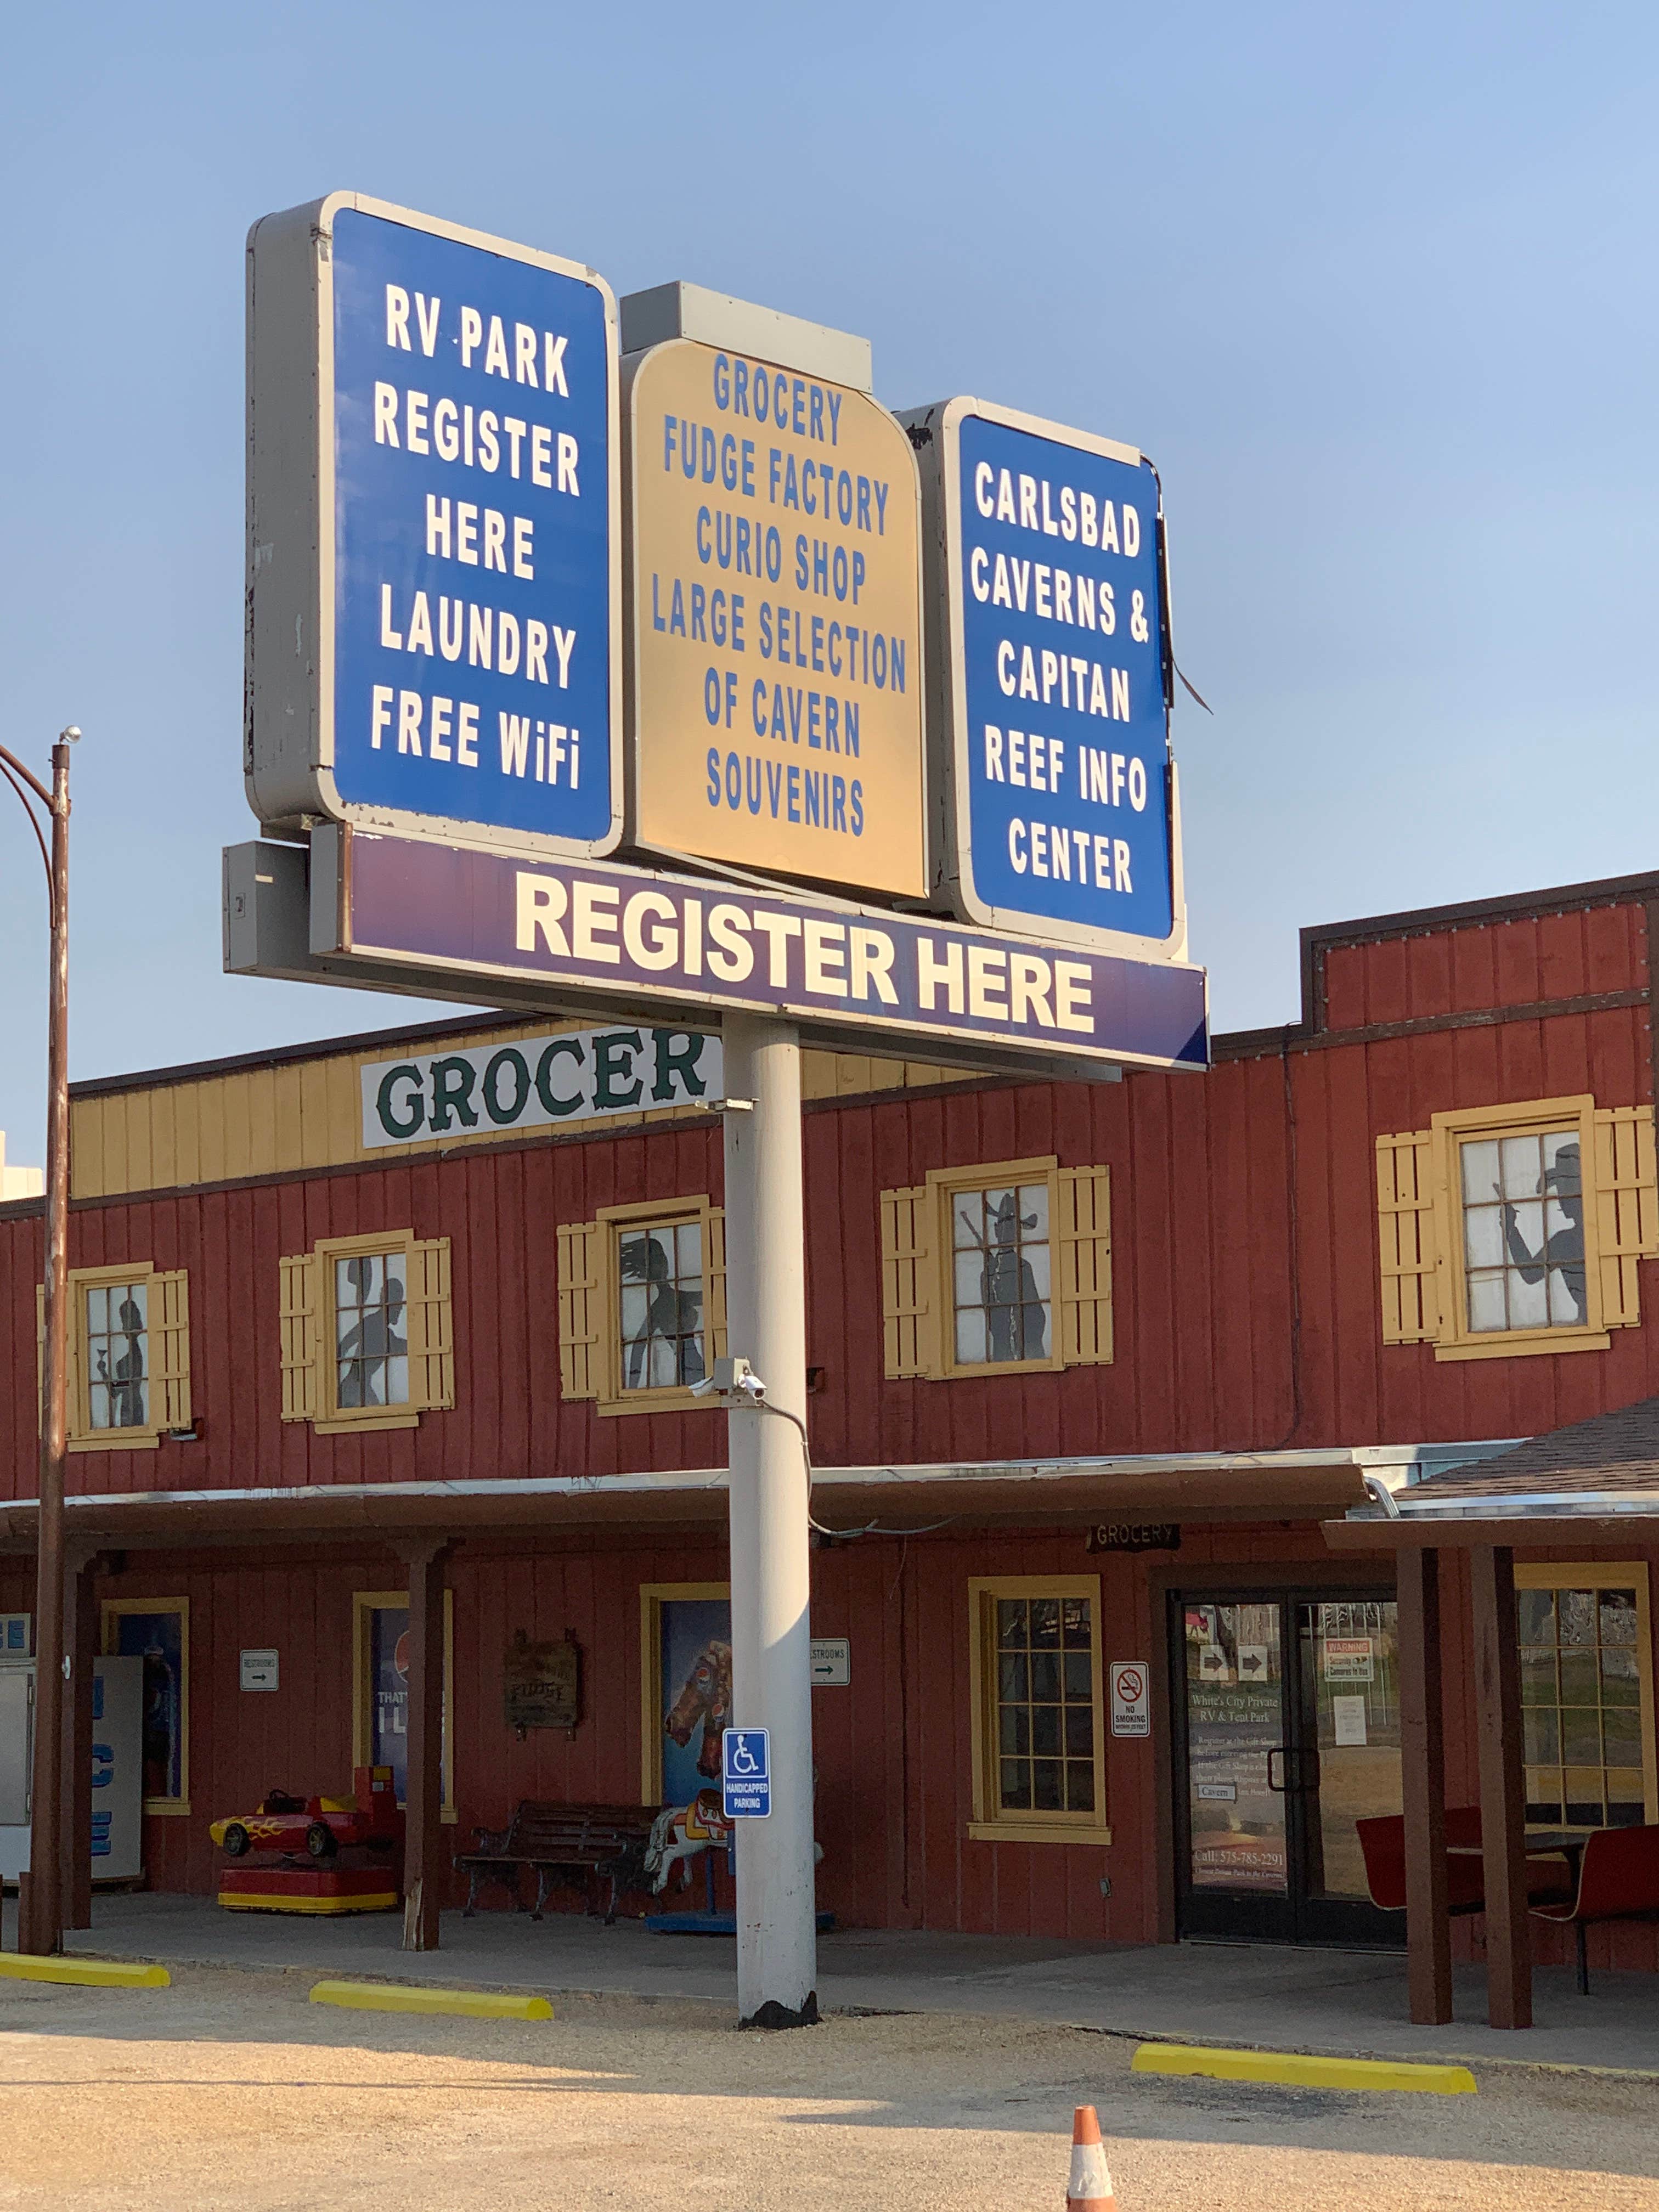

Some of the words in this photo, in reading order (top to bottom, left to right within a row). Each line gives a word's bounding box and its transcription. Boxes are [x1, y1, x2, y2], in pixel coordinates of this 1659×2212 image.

[386, 284, 440, 357] RV
[461, 306, 569, 398] PARK
[374, 381, 579, 497] REGISTER
[714, 354, 842, 445] GROCERY
[664, 415, 755, 496] FUDGE
[770, 448, 888, 535] FACTORY
[975, 461, 1140, 558] CARLSBAD
[426, 493, 534, 580] HERE
[697, 506, 781, 583] CURIO
[795, 534, 865, 605] SHOP
[381, 584, 577, 689] LAUNDRY
[652, 574, 744, 651] LARGE
[760, 602, 905, 693] SELECTION
[970, 547, 1115, 635] CAVERNS
[1131, 589, 1149, 642] &
[705, 667, 737, 728] OF
[753, 679, 860, 758] CAVERN
[998, 640, 1129, 723] CAPITAN
[371, 684, 479, 768] FREE
[499, 711, 579, 789] WiFi
[985, 725, 1064, 793] REEF
[1079, 746, 1146, 811] INFO
[707, 747, 864, 837] SOUVENIRS
[1009, 817, 1132, 893] CENTER
[516, 872, 899, 1005] REGISTER
[918, 938, 1094, 1034] HERE
[376, 1028, 707, 1139] GROCER
[1097, 1524, 1172, 1545] GROCERY
[810, 1649, 844, 1659] STROOMS
[1329, 1642, 1368, 1652] WARNING
[377, 1691, 408, 1704] THAT'
[1115, 1714, 1146, 1723] SMOKING
[1126, 1705, 1135, 1713] NO
[1192, 1695, 1224, 1706] White's
[1226, 1695, 1245, 1708] City
[1248, 1696, 1278, 1707] Private
[1200, 1711, 1216, 1722] RV
[1218, 1711, 1226, 1722] &
[1228, 1711, 1248, 1722] Tent
[1250, 1712, 1270, 1723] Park
[726, 1783, 768, 1794] HANDICAPPED
[734, 1798, 760, 1809] PARKING
[1220, 1850, 1283, 1865] 575-785-2291
